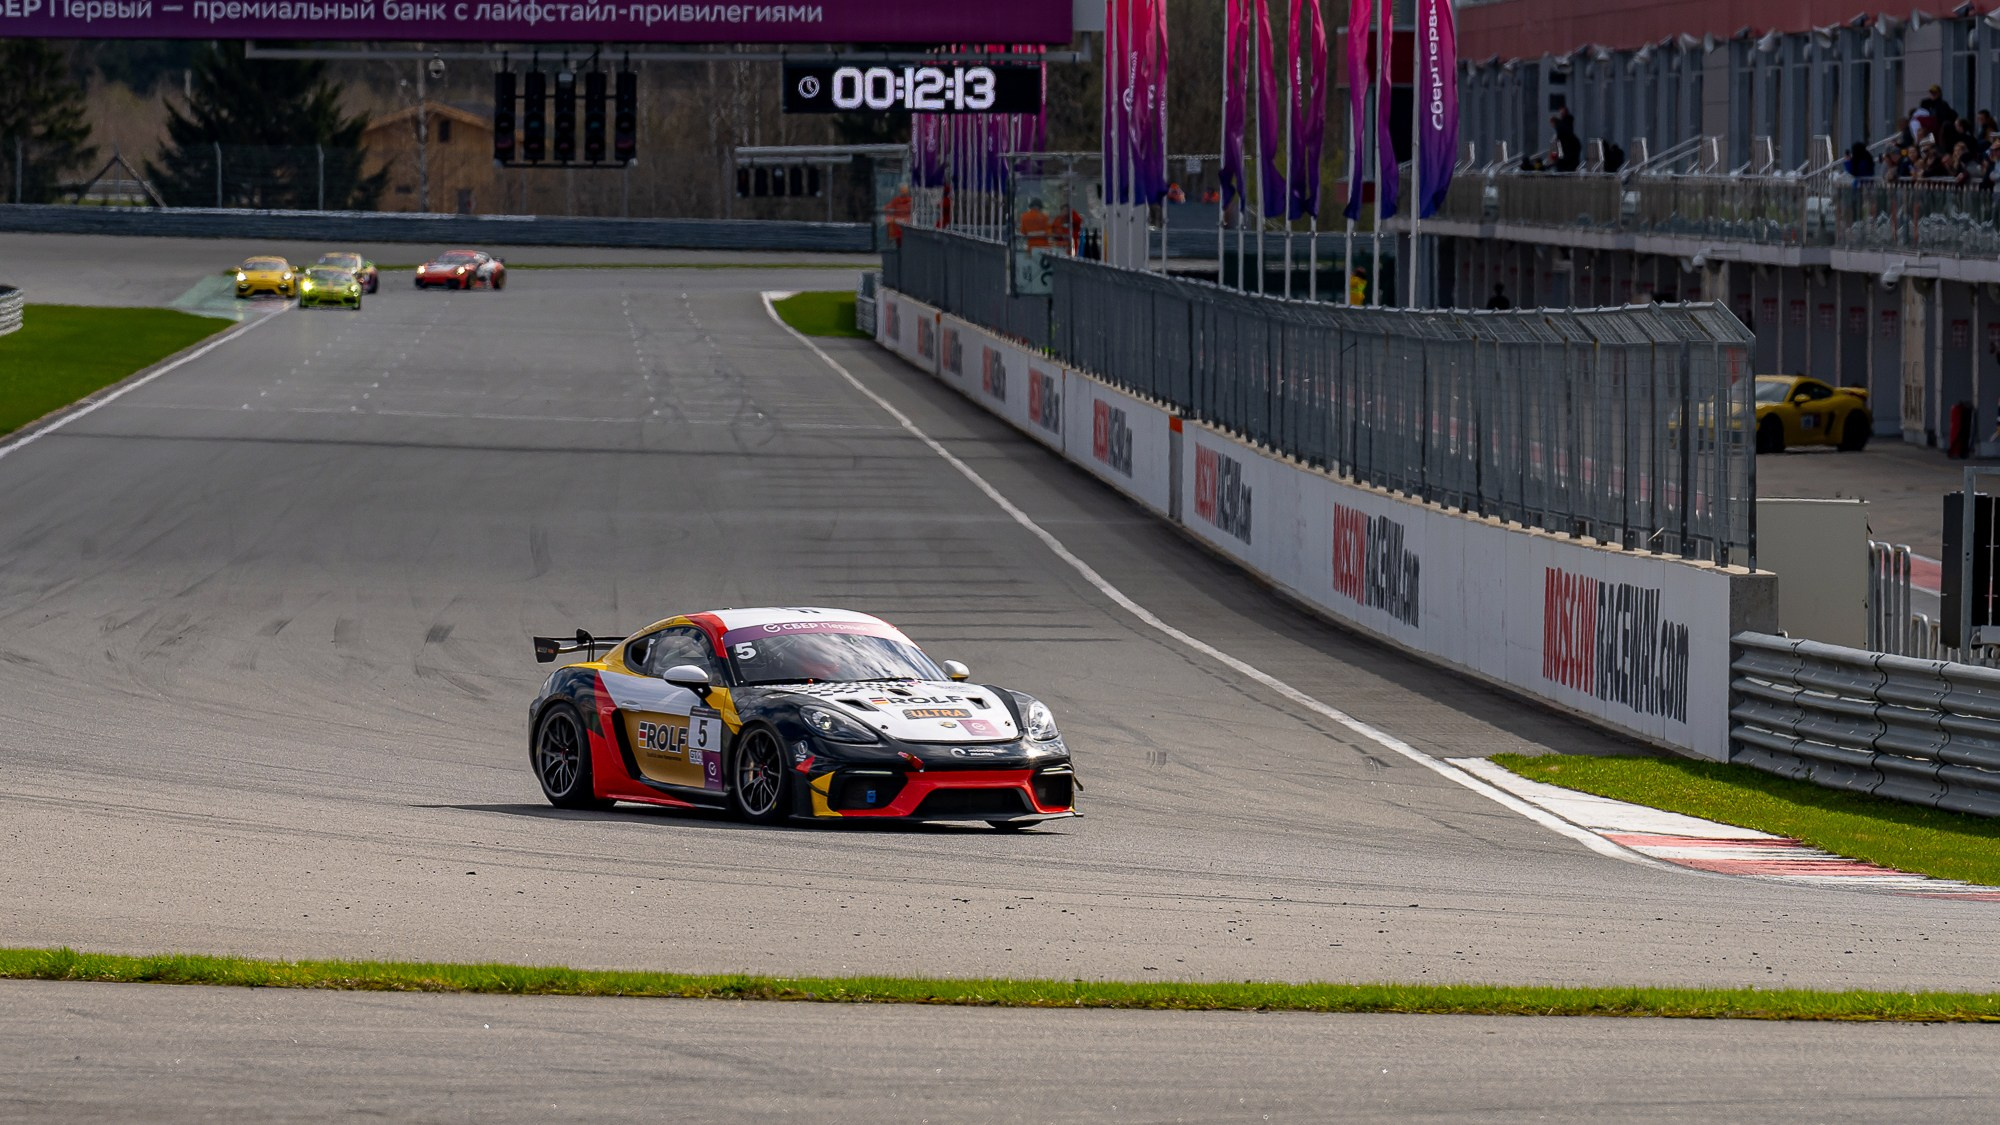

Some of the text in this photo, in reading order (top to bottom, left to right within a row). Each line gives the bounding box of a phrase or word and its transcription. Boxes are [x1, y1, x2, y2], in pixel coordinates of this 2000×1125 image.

[50, 0, 151, 23] Первый
[193, 0, 375, 24] премиальный
[383, 0, 447, 20] банк
[454, 2, 468, 20] с
[474, 0, 823, 27] лайфстайл-привилегиями
[832, 66, 997, 110] 00:12:13
[782, 622, 819, 630] СБЕР
[735, 642, 757, 660] 5
[1543, 566, 1690, 725] MOSCOWRACEWAY.com
[885, 695, 963, 705] ROLF
[911, 709, 966, 718] ULTRA
[646, 722, 689, 754] ROLF
[697, 719, 708, 748] 5
